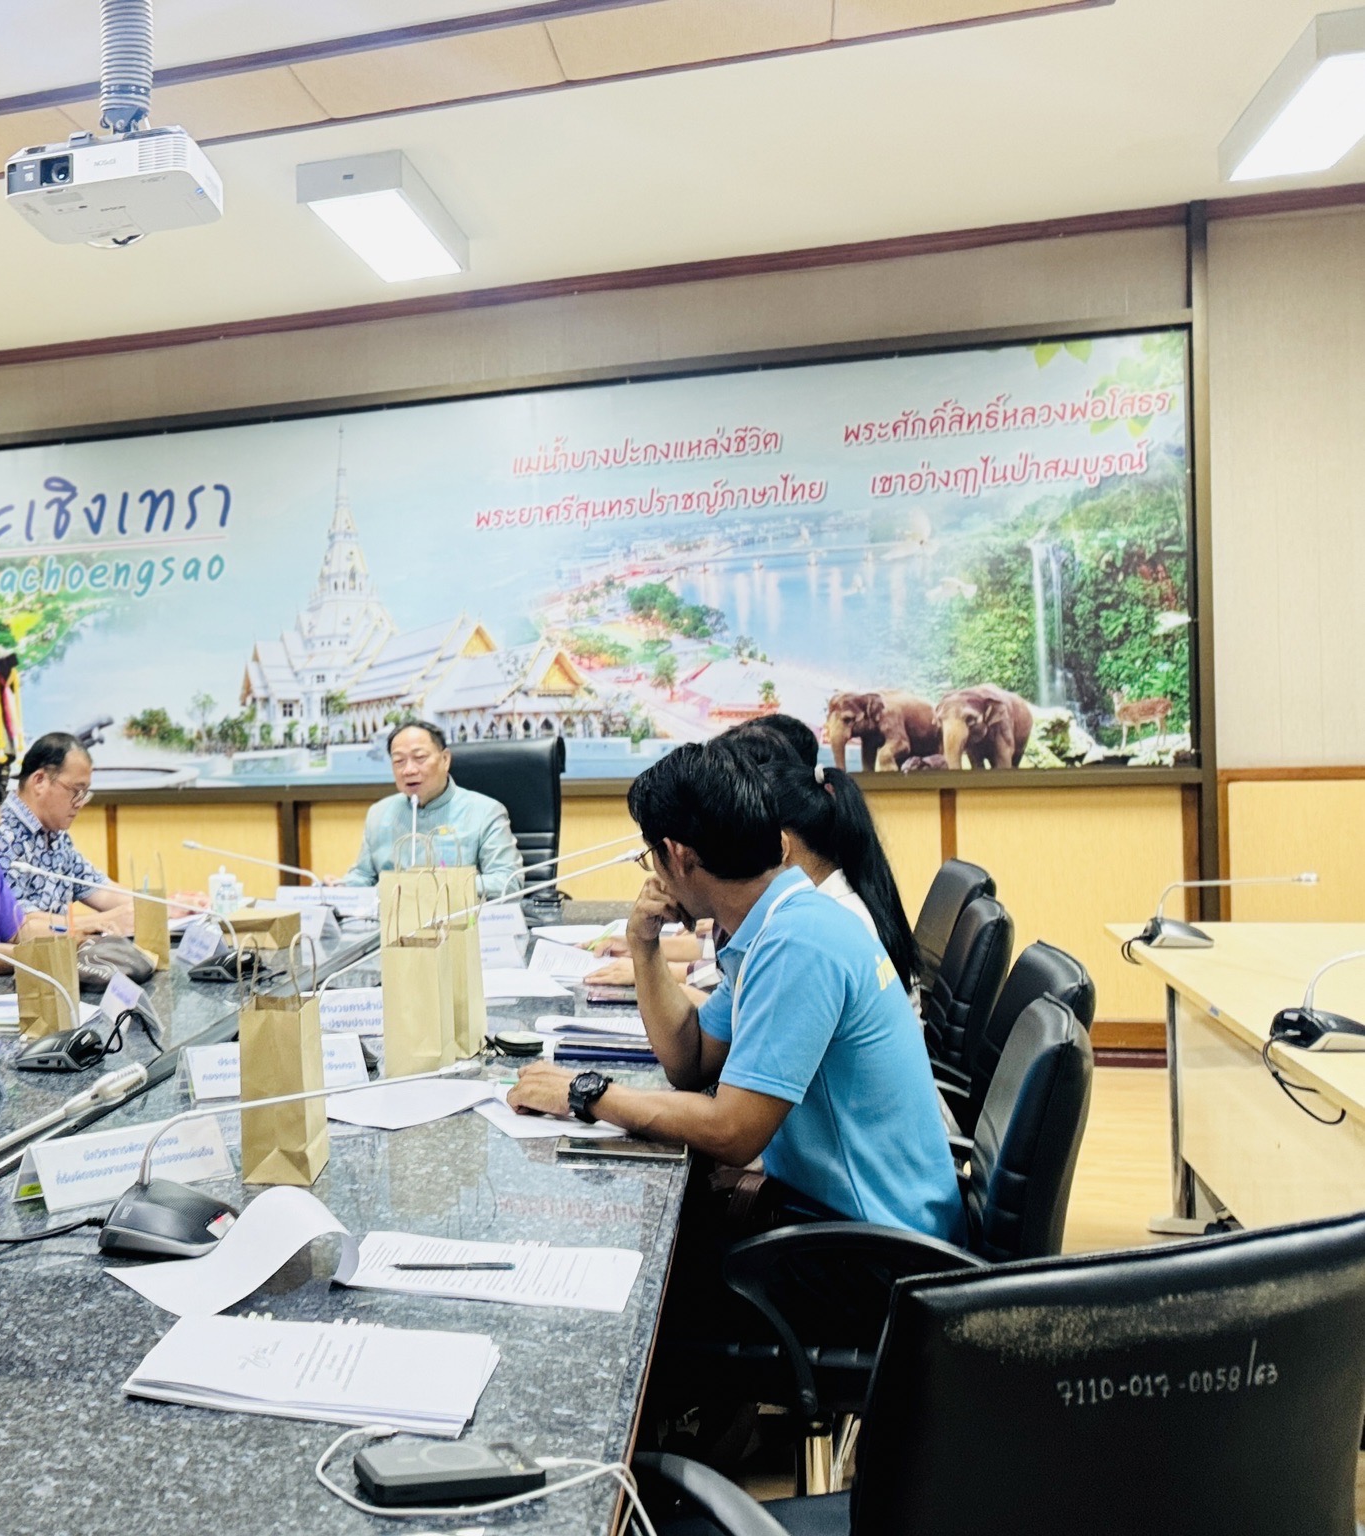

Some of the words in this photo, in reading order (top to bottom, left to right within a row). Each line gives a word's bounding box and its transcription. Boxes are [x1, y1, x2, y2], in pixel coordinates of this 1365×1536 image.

[843, 389, 1171, 444] พระศักดิ์สิทธิ์หลวงพ่อโสธร
[512, 425, 781, 475] แม่น้ำบางปะกงแหล่งชีวิต
[870, 441, 1148, 495] เขาอ่างฤๅไนป่าสมบูรณ์
[475, 474, 826, 530] พระยาศรีสุนทรปราชญ์ภาษาไทย
